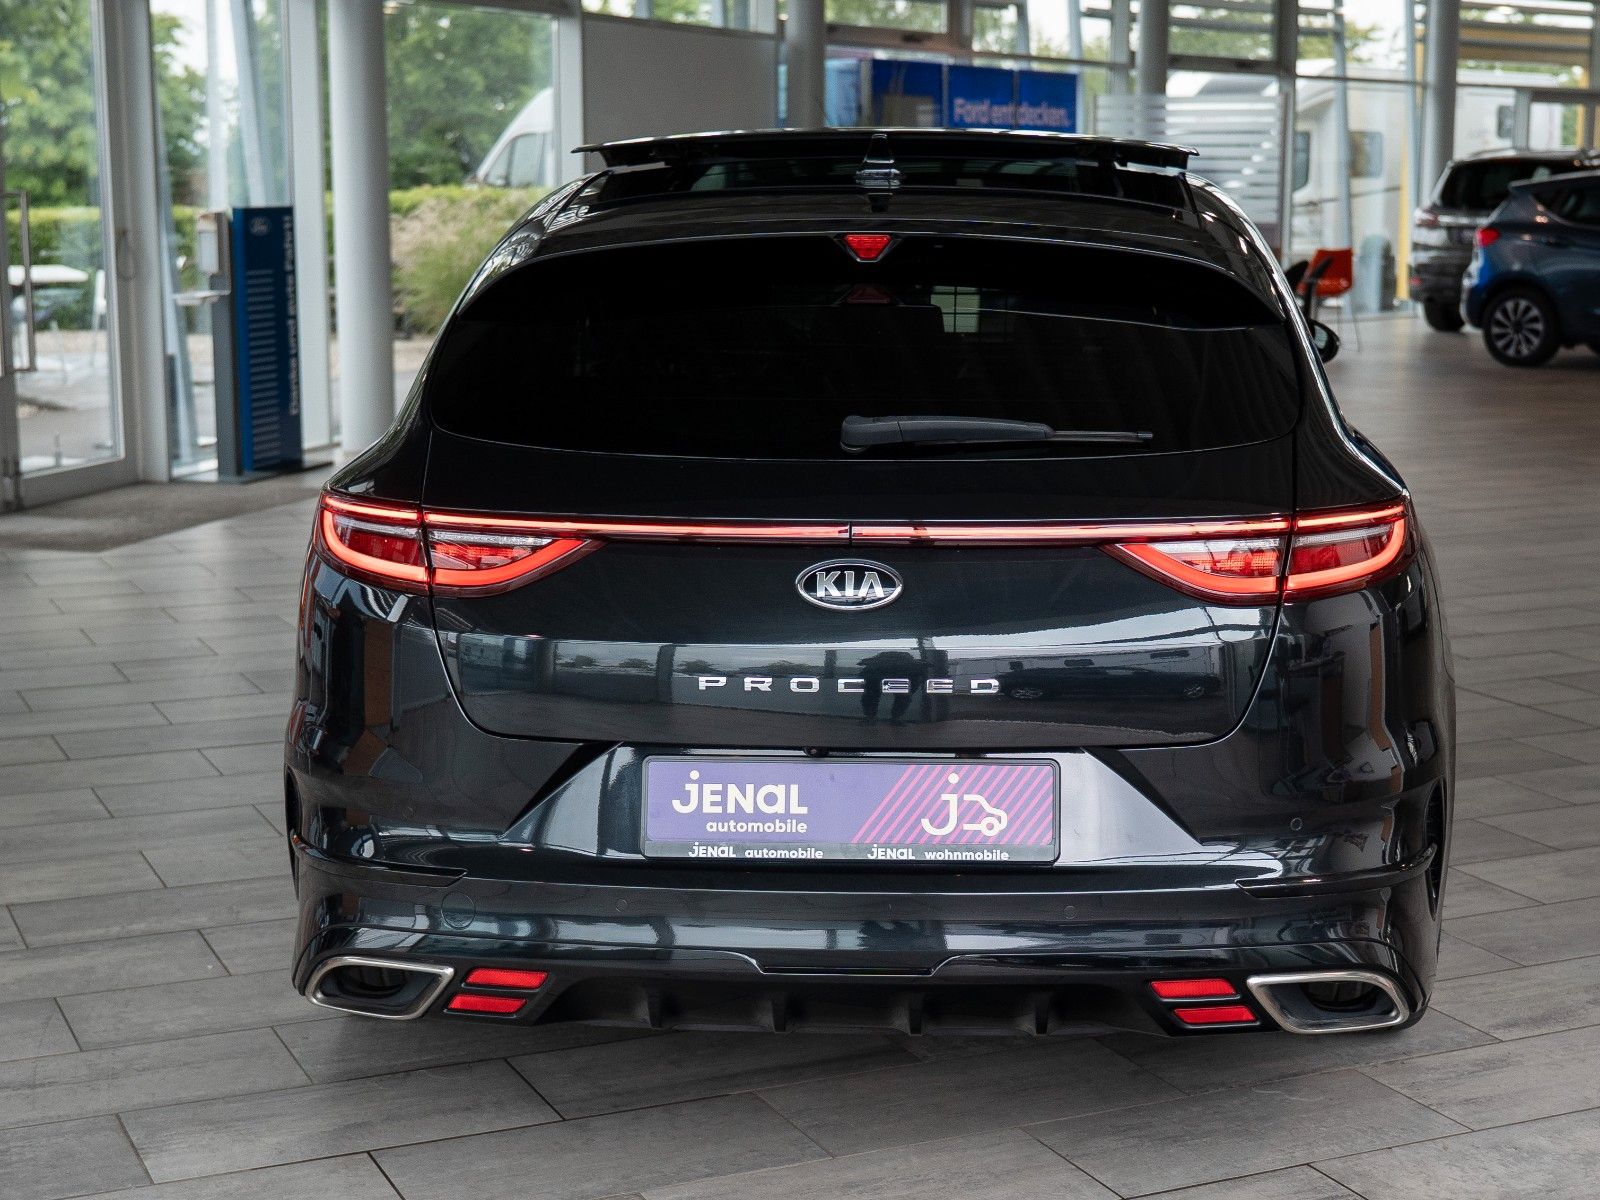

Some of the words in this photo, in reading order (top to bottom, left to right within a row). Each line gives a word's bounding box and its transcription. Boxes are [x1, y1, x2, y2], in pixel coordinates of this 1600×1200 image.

[816, 571, 885, 598] KIA
[698, 676, 1000, 694] PROCEED
[706, 819, 808, 833] automobile
[745, 848, 824, 860] automobile
[924, 849, 1010, 861] wohnmobile
